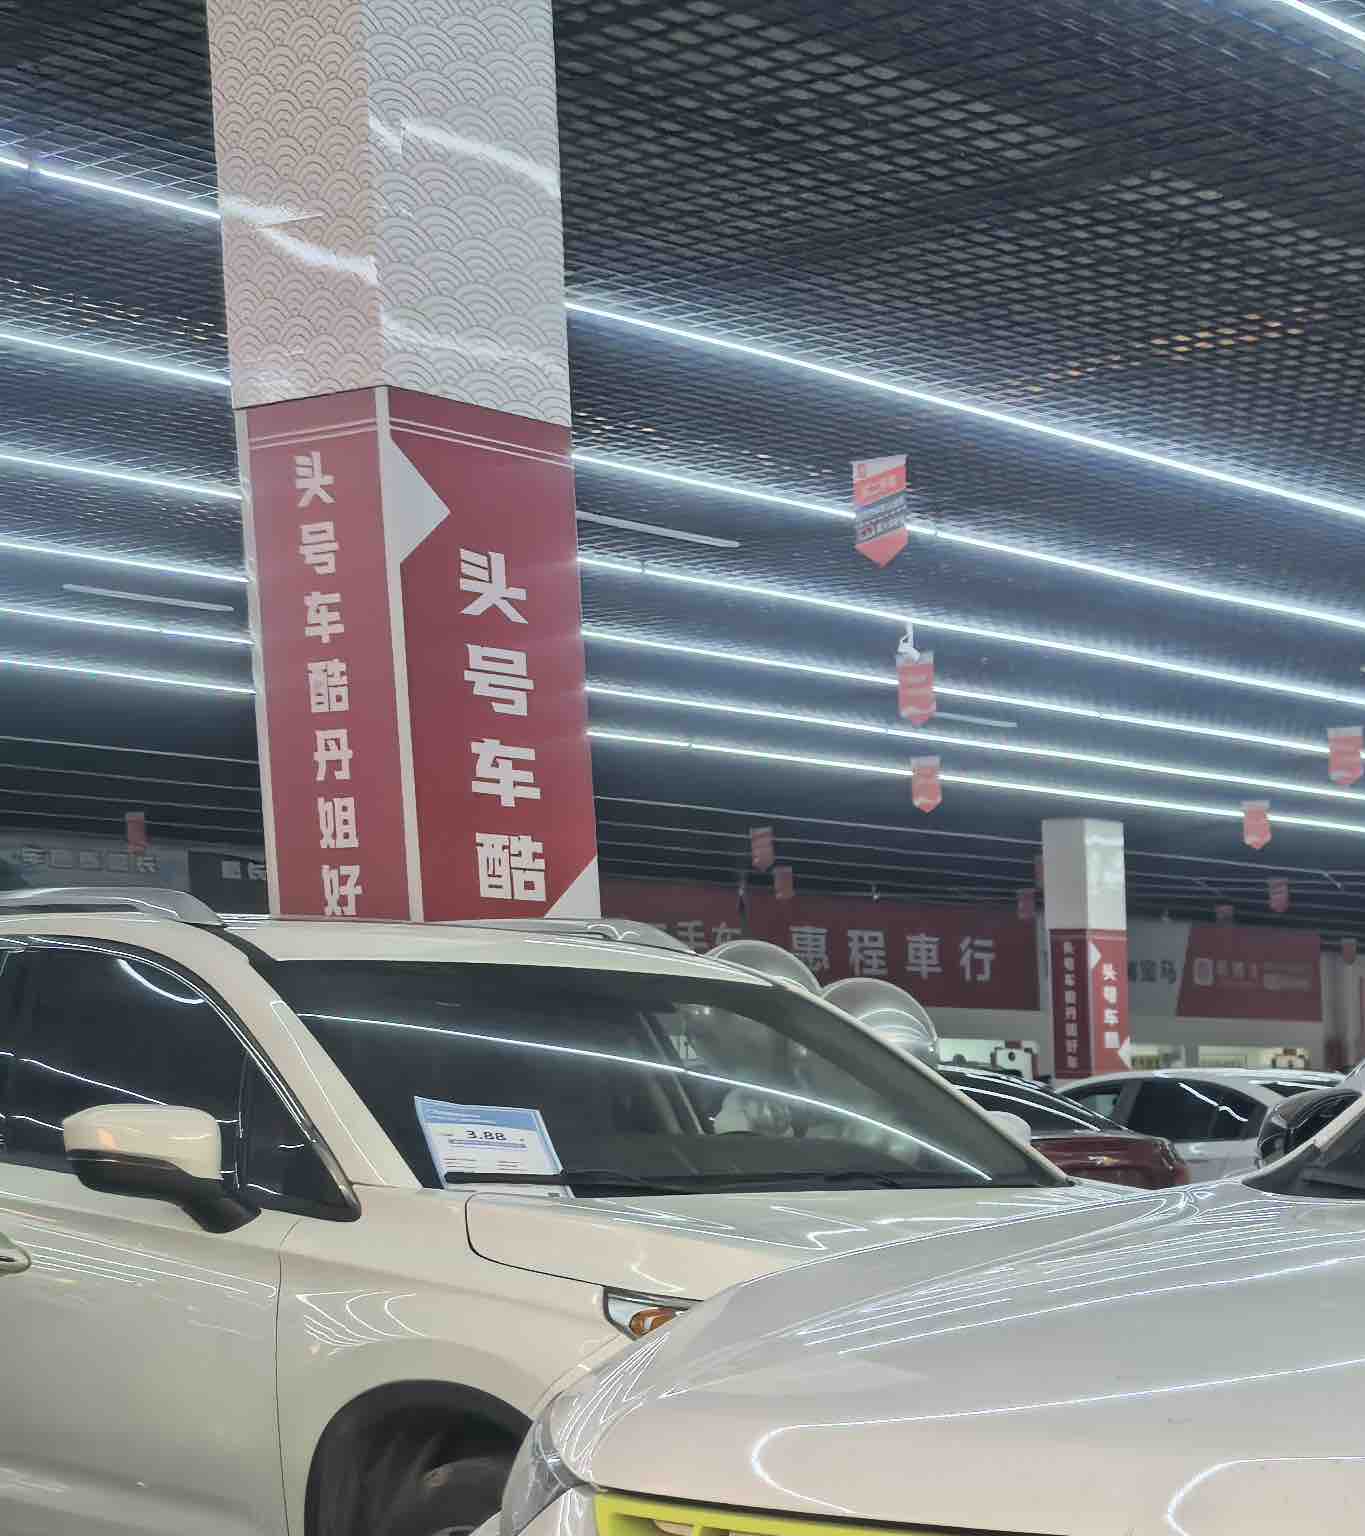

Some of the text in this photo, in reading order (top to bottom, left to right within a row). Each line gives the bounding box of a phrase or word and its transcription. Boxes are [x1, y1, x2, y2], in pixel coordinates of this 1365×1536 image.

[458, 547, 548, 903] 头号车酷
[466, 1129, 507, 1141] 3.88
